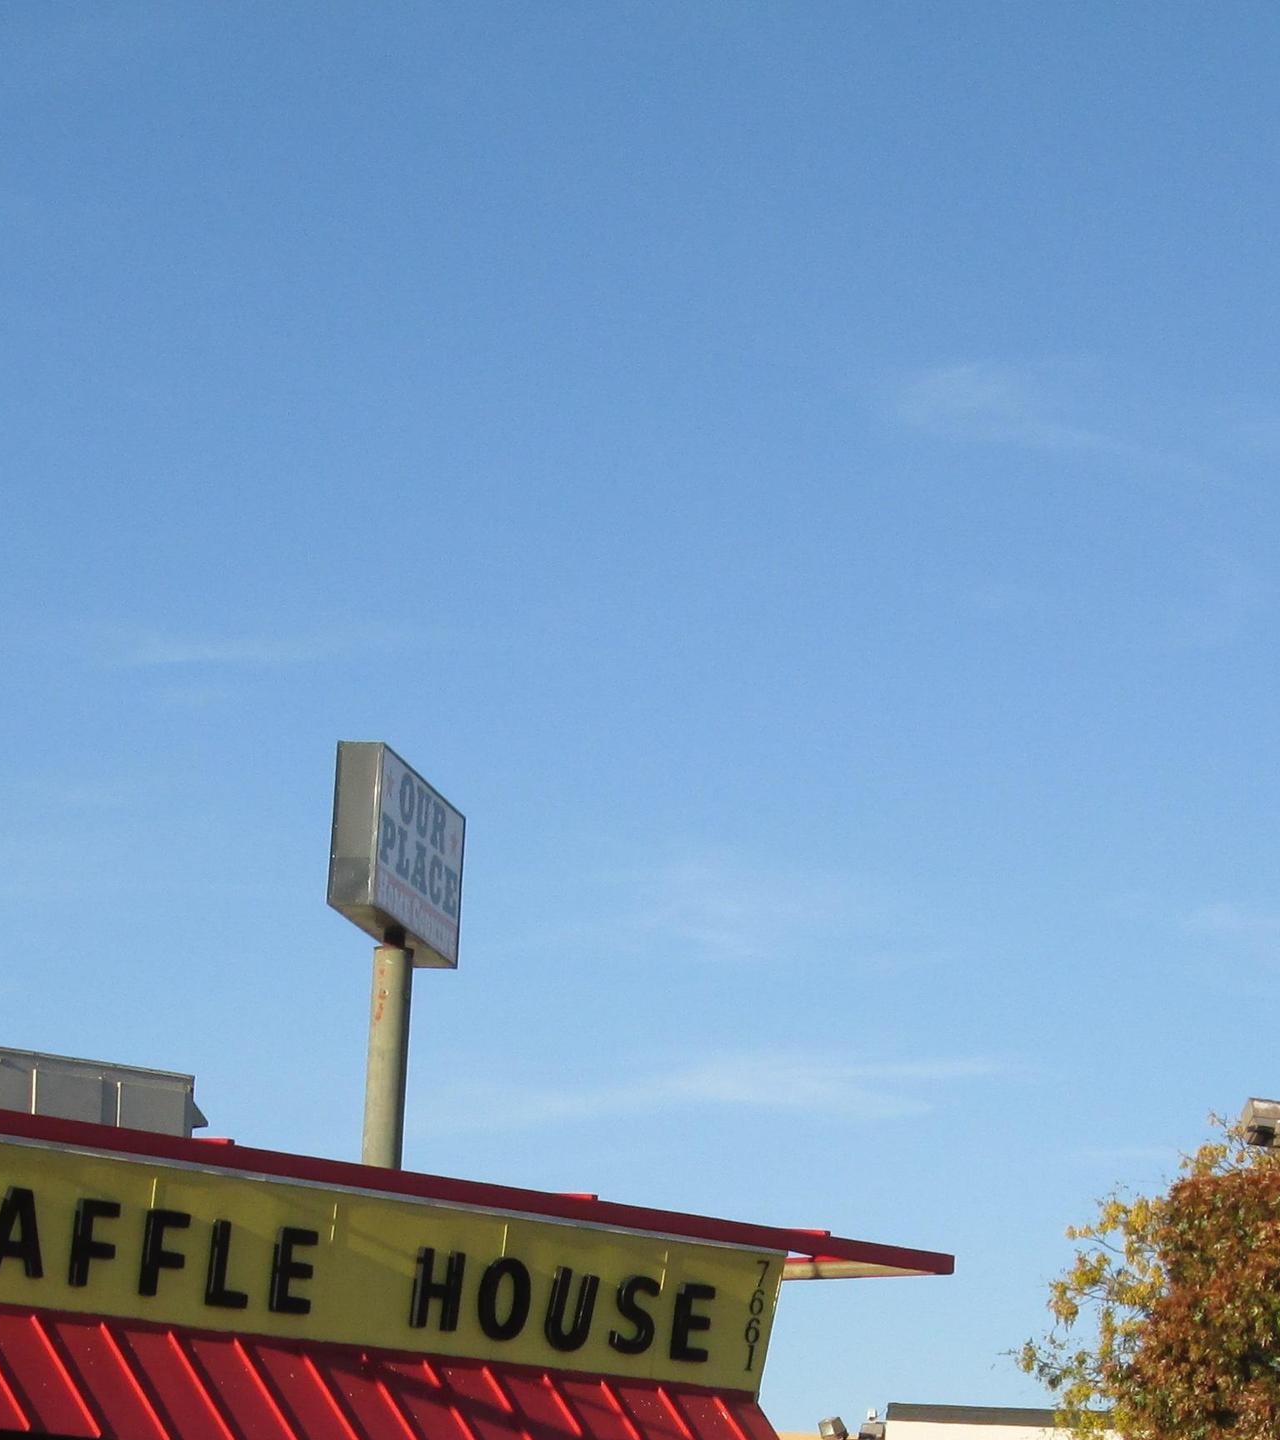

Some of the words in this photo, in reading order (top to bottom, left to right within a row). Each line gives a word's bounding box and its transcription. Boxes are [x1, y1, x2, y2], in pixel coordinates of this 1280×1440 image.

[380, 812, 458, 912] PLACE
[400, 771, 446, 855] OUR
[409, 1246, 715, 1364] HOUSE
[744, 1259, 770, 1371] 7661
